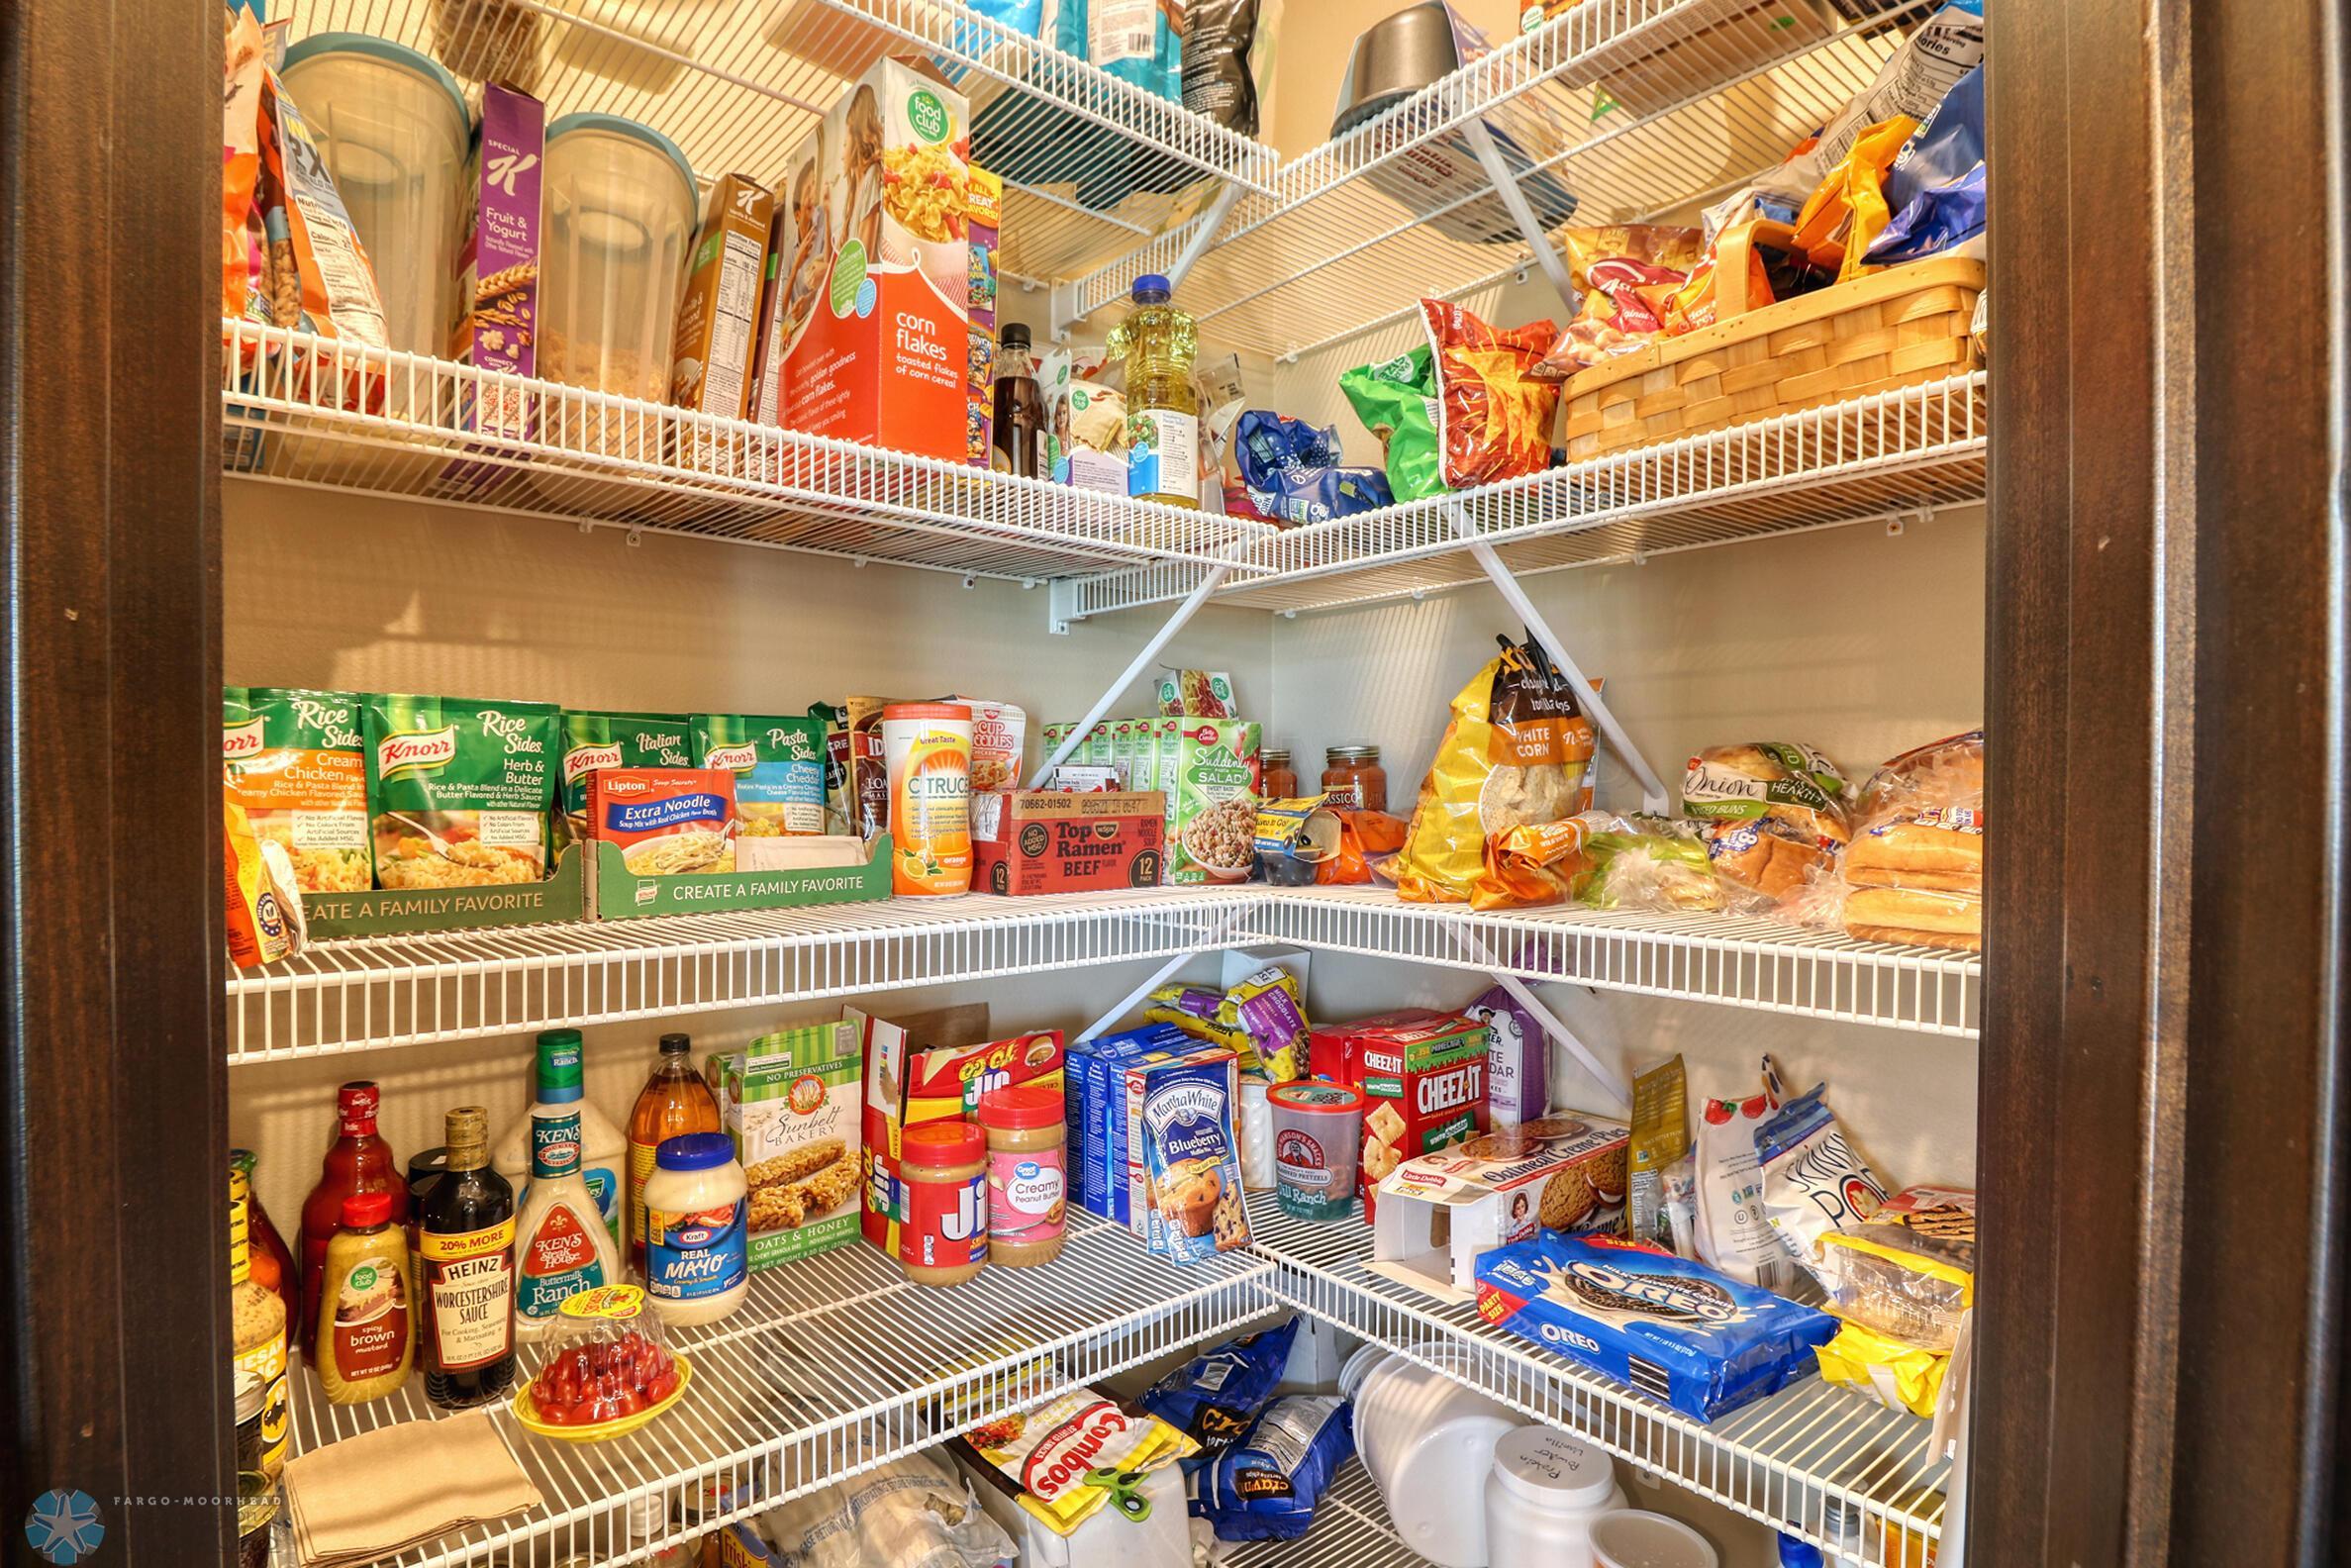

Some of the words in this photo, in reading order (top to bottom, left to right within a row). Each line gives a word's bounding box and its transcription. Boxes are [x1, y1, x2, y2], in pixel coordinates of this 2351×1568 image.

[915, 98, 941, 121] food
[916, 114, 939, 134] club
[488, 140, 521, 155] SPECIAL
[487, 153, 539, 196] K
[974, 183, 989, 196] ALL
[969, 192, 993, 206] REAT
[486, 206, 515, 226] Fruit
[518, 217, 528, 230] &
[486, 219, 528, 242] Yogurt
[896, 312, 935, 336] corn
[896, 329, 947, 361] flakes
[896, 351, 931, 370] toasted
[934, 361, 958, 380] flakes
[896, 364, 907, 374] of
[909, 368, 930, 381] corn
[931, 373, 956, 389] cereal
[291, 700, 348, 731] Rice
[476, 710, 527, 736] Rice
[978, 721, 1006, 735] CUP
[224, 735, 258, 752] orr
[636, 733, 681, 753] Italian
[767, 728, 809, 749] Pasta
[973, 735, 1014, 750] OODLES
[380, 740, 451, 765] Knorr
[1517, 742, 1549, 757] CORN
[317, 753, 364, 768] Cream
[504, 758, 534, 772] Herb
[536, 760, 544, 772] &
[565, 752, 620, 773] Knorr
[712, 751, 755, 769] Knorr
[1193, 747, 1250, 779] Suddenly
[284, 766, 344, 782] Chicken
[506, 772, 542, 785] Butter
[786, 773, 820, 785] Cheddar
[792, 764, 820, 777] Cheesy
[1198, 772, 1241, 783] SALAD
[273, 780, 293, 790] Rice
[295, 781, 303, 790] &
[306, 782, 330, 791] Pasta
[457, 783, 479, 792] Pasta
[516, 785, 543, 795] Delicate
[608, 780, 645, 793] Lipton
[1684, 766, 1758, 797] Onion
[270, 788, 306, 798] Chicken
[437, 791, 463, 800] Butter
[465, 791, 495, 800] Flavored
[504, 792, 520, 801] Herb
[521, 793, 542, 802] Sauce
[625, 807, 662, 821] Extra
[664, 796, 711, 815] Noodle
[1717, 804, 1747, 816] BUNS
[619, 820, 635, 829] Soup
[645, 819, 657, 828] with
[657, 817, 669, 826] Real
[670, 812, 690, 824] Chicken
[1056, 823, 1092, 841] Top
[1057, 842, 1124, 858] Ramen
[943, 857, 967, 866] orange
[1064, 860, 1101, 877] BEEF
[1139, 857, 1153, 876] 12
[995, 867, 1006, 883] 12
[674, 882, 733, 901] CREATE
[735, 884, 746, 897] A
[750, 880, 799, 897] FAMILY
[802, 876, 863, 893] FAVORITE
[304, 904, 352, 922] EATE
[358, 902, 373, 918] A
[380, 898, 450, 918] FAMILY
[455, 893, 543, 913] FAVORITE
[1274, 988, 1289, 1005] MILK
[1268, 993, 1297, 1029] CHOCOLATE
[553, 1057, 577, 1067] Ranch
[766, 1072, 781, 1083] NO
[784, 1060, 842, 1080] PRESERVATIVES
[1153, 1096, 1187, 1125] Martha
[1188, 1090, 1219, 1110] White
[765, 1105, 843, 1143] Sunbelt
[537, 1124, 581, 1143] KEN'S
[775, 1124, 836, 1147] BAKERY
[1169, 1131, 1222, 1155] Blueberry
[1483, 1153, 1552, 1183] Oatmeal
[1550, 1136, 1598, 1163] Creme
[1596, 1127, 1629, 1146] Pies
[874, 1154, 891, 1213] Jif
[1299, 1172, 1328, 1181] PRETZELS
[1403, 1169, 1420, 1181] Little
[1420, 1174, 1445, 1186] Debbie
[1016, 1181, 1059, 1195] Creamy
[1016, 1194, 1041, 1204] Peanut
[1043, 1190, 1060, 1202] Butter
[1292, 1187, 1327, 1205] Ranch
[941, 1179, 987, 1239] Ji
[441, 1240, 466, 1250] 20%
[469, 1229, 504, 1248] MORE
[536, 1232, 582, 1252] KEN'S
[755, 1234, 787, 1251] OATS
[793, 1230, 802, 1241] &
[807, 1217, 849, 1237] HONEY
[1606, 1237, 1636, 1248] SIZE
[539, 1247, 571, 1261] Steak
[543, 1252, 582, 1269] House
[681, 1249, 711, 1260] REAL
[447, 1258, 499, 1280] HEINZ
[665, 1253, 729, 1279] MAYO
[355, 1272, 372, 1283] food
[355, 1278, 371, 1287] club
[539, 1270, 582, 1287] Buttermilk
[436, 1277, 509, 1309] WORCESTERSHIRE
[532, 1279, 590, 1305] Ranch
[1567, 1260, 1733, 1323] OREO
[1480, 1293, 1502, 1315] PARTY
[1488, 1304, 1506, 1322] SIZE
[459, 1303, 488, 1324] SAUCE
[361, 1324, 382, 1333] spicy
[350, 1330, 395, 1346] brown
[1540, 1323, 1601, 1354] OREO
[355, 1342, 389, 1354] mustard
[1036, 1412, 1127, 1497] Combos
